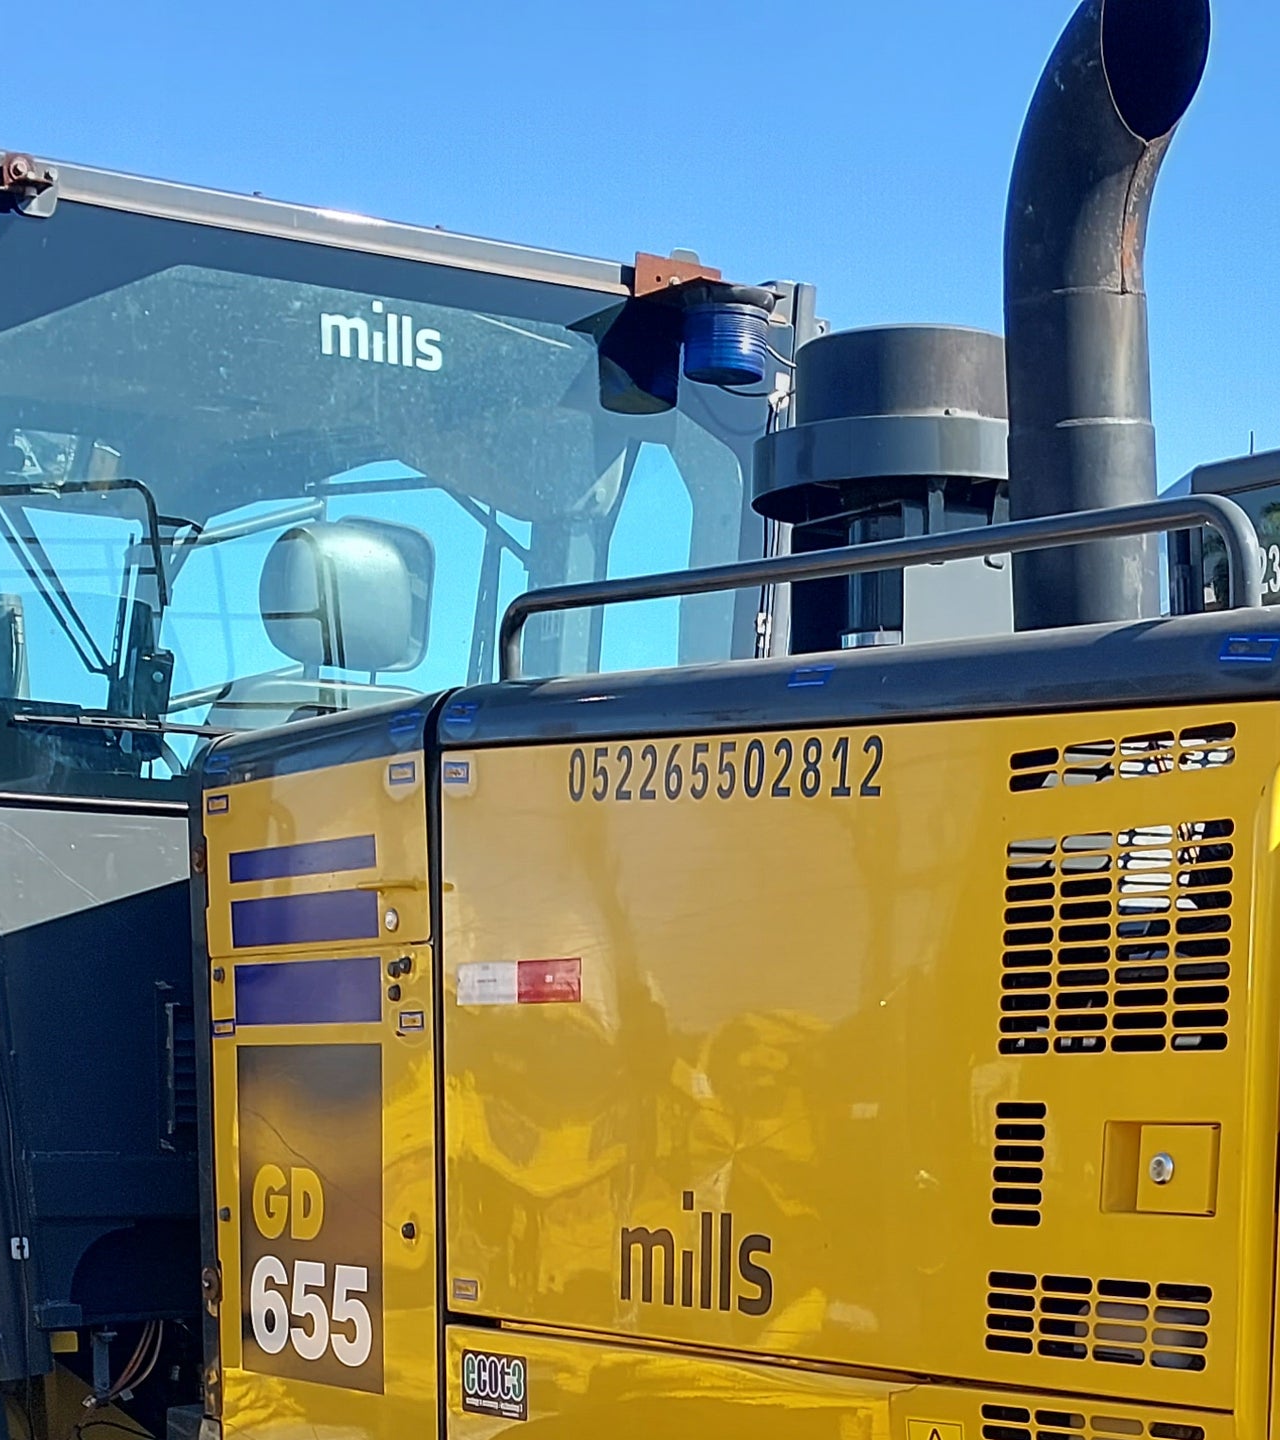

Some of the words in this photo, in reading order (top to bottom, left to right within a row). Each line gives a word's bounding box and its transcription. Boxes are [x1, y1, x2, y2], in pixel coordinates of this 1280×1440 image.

[320, 299, 443, 372] mills
[568, 735, 884, 802] 052265502812
[252, 1164, 325, 1242] GD
[620, 1190, 774, 1317] mills
[250, 1255, 373, 1368] 655
